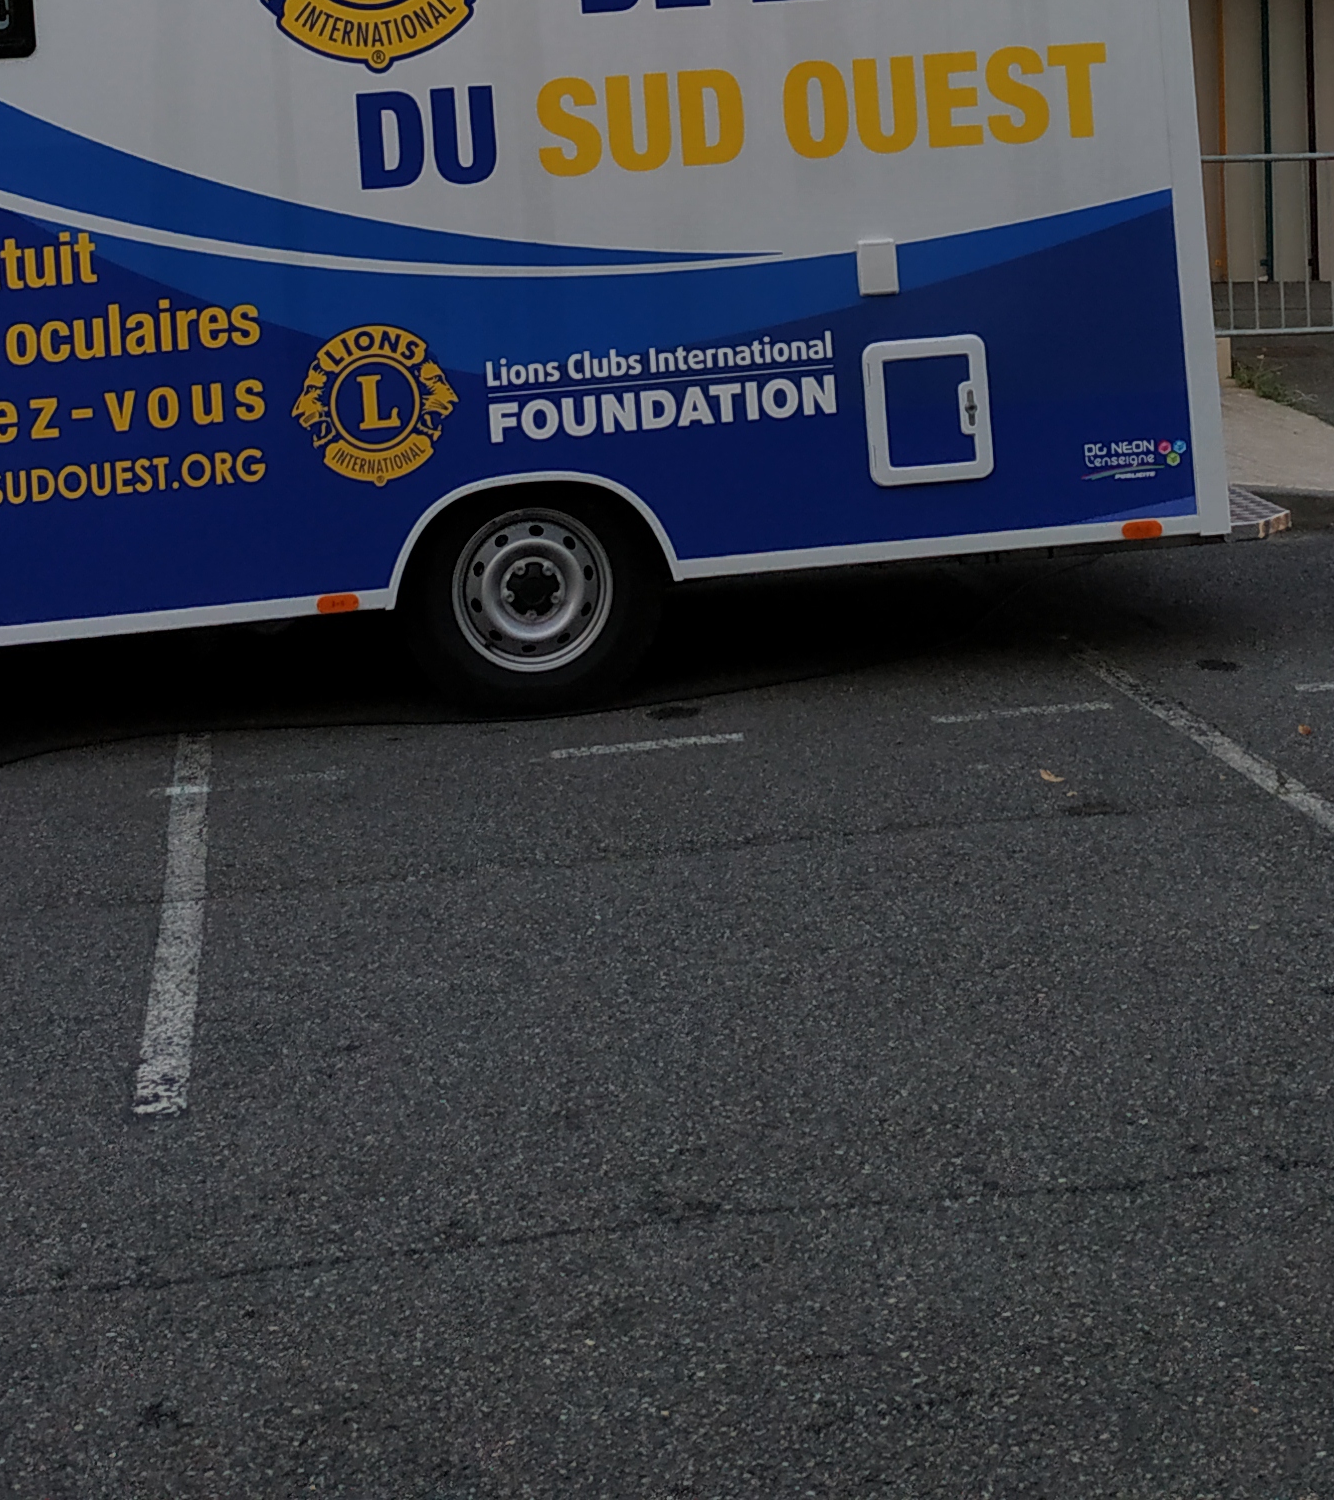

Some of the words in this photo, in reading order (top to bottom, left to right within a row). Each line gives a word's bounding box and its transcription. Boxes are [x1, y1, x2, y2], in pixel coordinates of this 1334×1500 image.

[356, 85, 496, 190] DU
[537, 68, 745, 177] SUD
[782, 41, 1107, 159] OUEST
[6, 299, 260, 366] oculaires
[324, 330, 420, 367] LIONS
[485, 357, 561, 387] Lions
[567, 348, 642, 380] Clubs
[648, 330, 833, 373] International
[356, 374, 401, 431] L
[488, 374, 837, 443] FOUNDATION
[332, 442, 426, 475] INTERNATIONAL
[1083, 443, 1107, 456] DG
[1110, 440, 1155, 454] NEON
